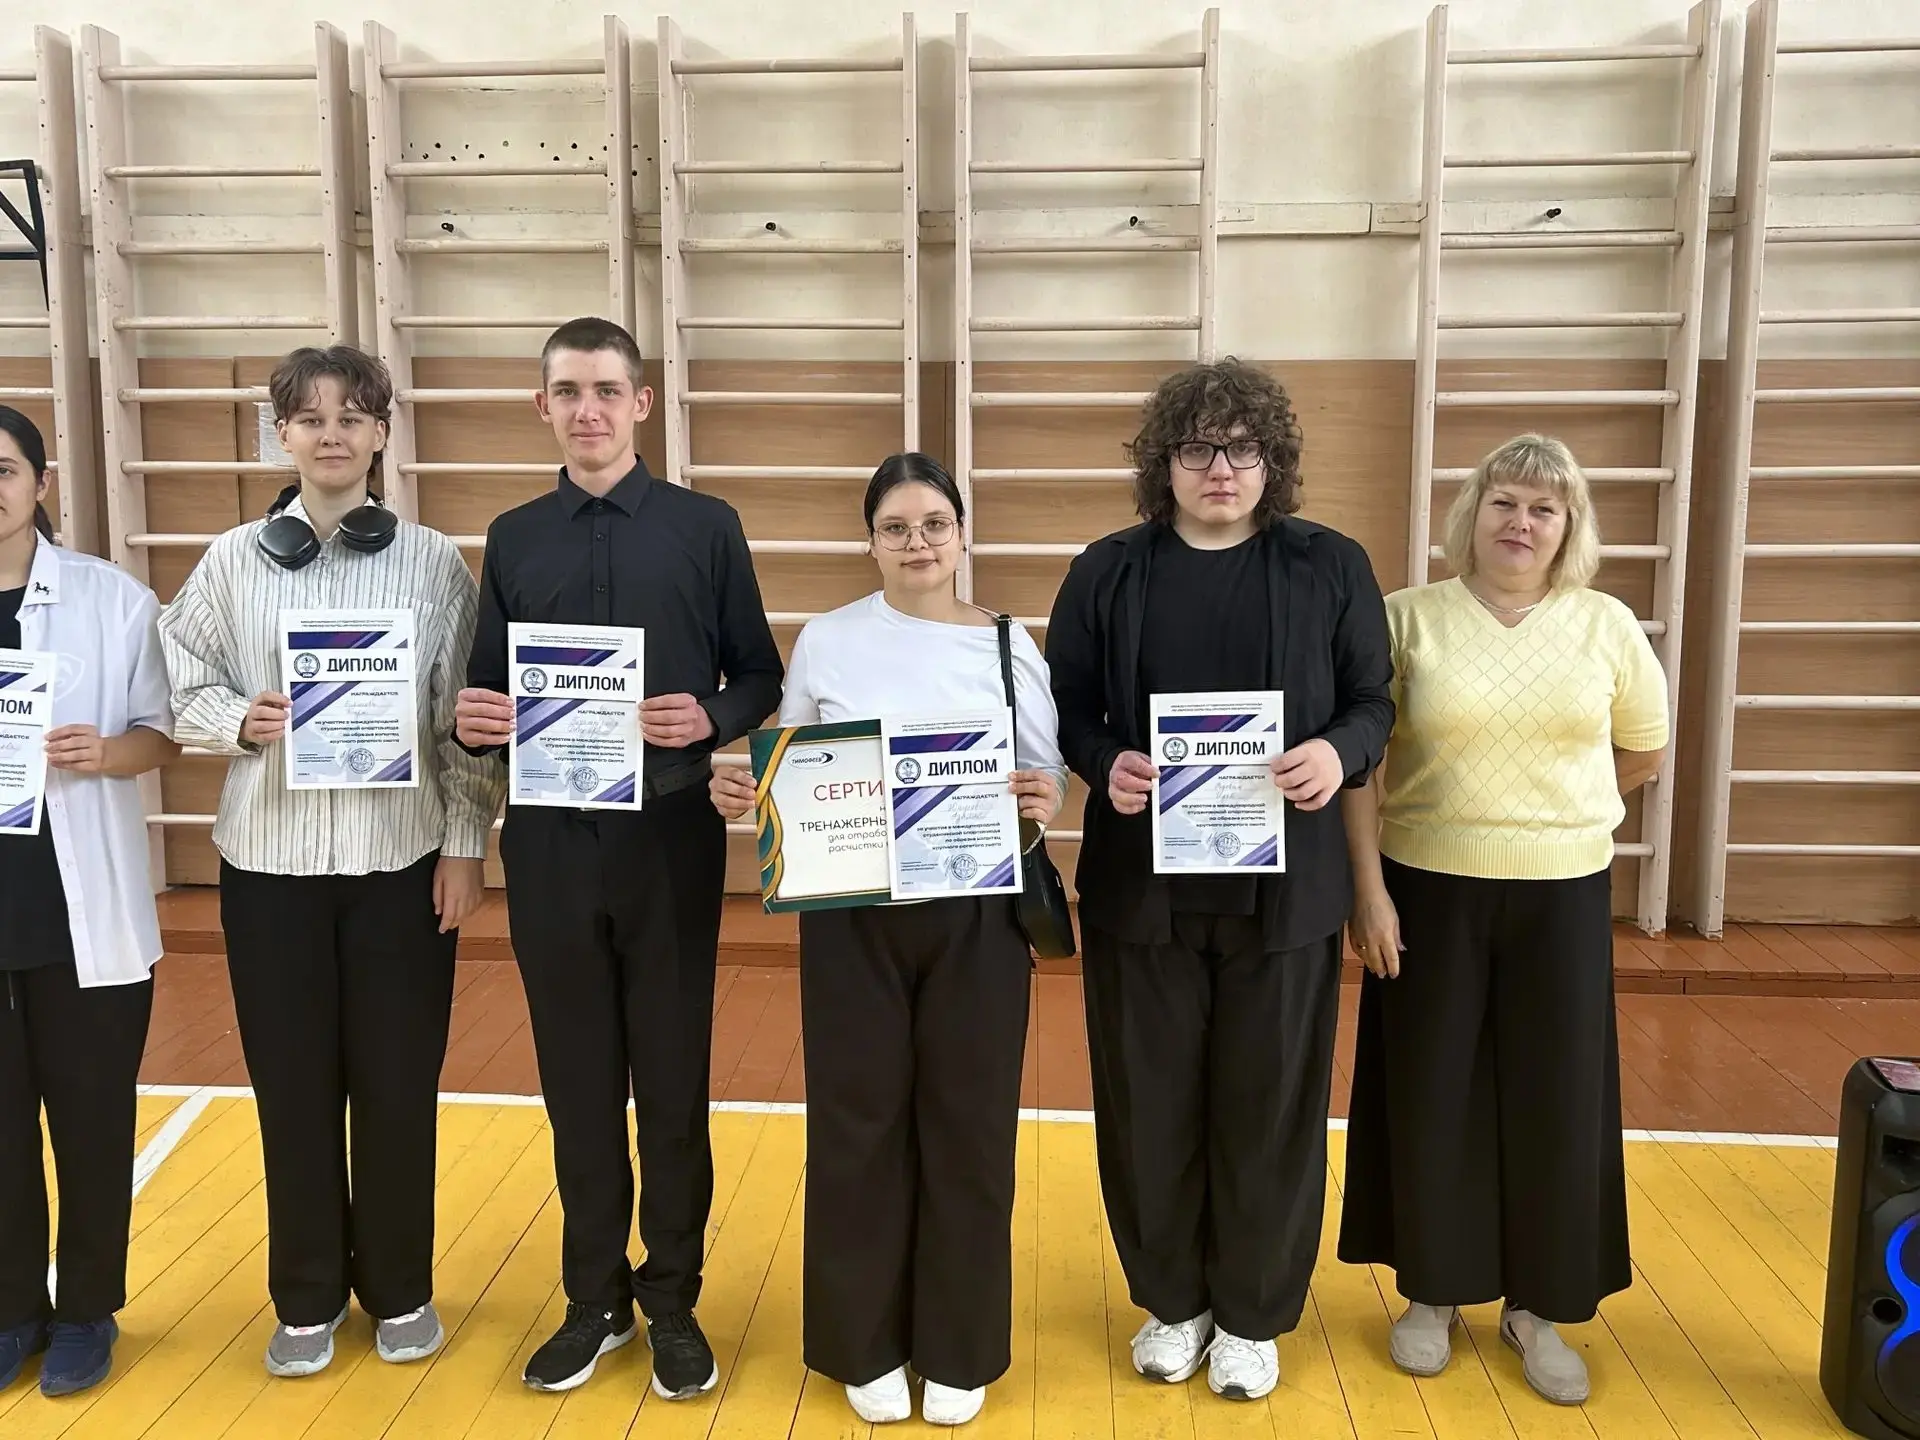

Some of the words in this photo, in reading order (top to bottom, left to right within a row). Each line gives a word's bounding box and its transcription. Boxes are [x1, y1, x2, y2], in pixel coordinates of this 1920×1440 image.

[326, 658, 398, 672] ДИПЛОМ
[554, 674, 625, 691] ДИПЛОМ
[1195, 741, 1265, 755] ДИПЛОМ
[927, 759, 998, 776] ДИПЛОМ
[813, 780, 883, 801] СЕРТИ
[847, 828, 887, 840] отрабо
[828, 842, 883, 855] расчистки
